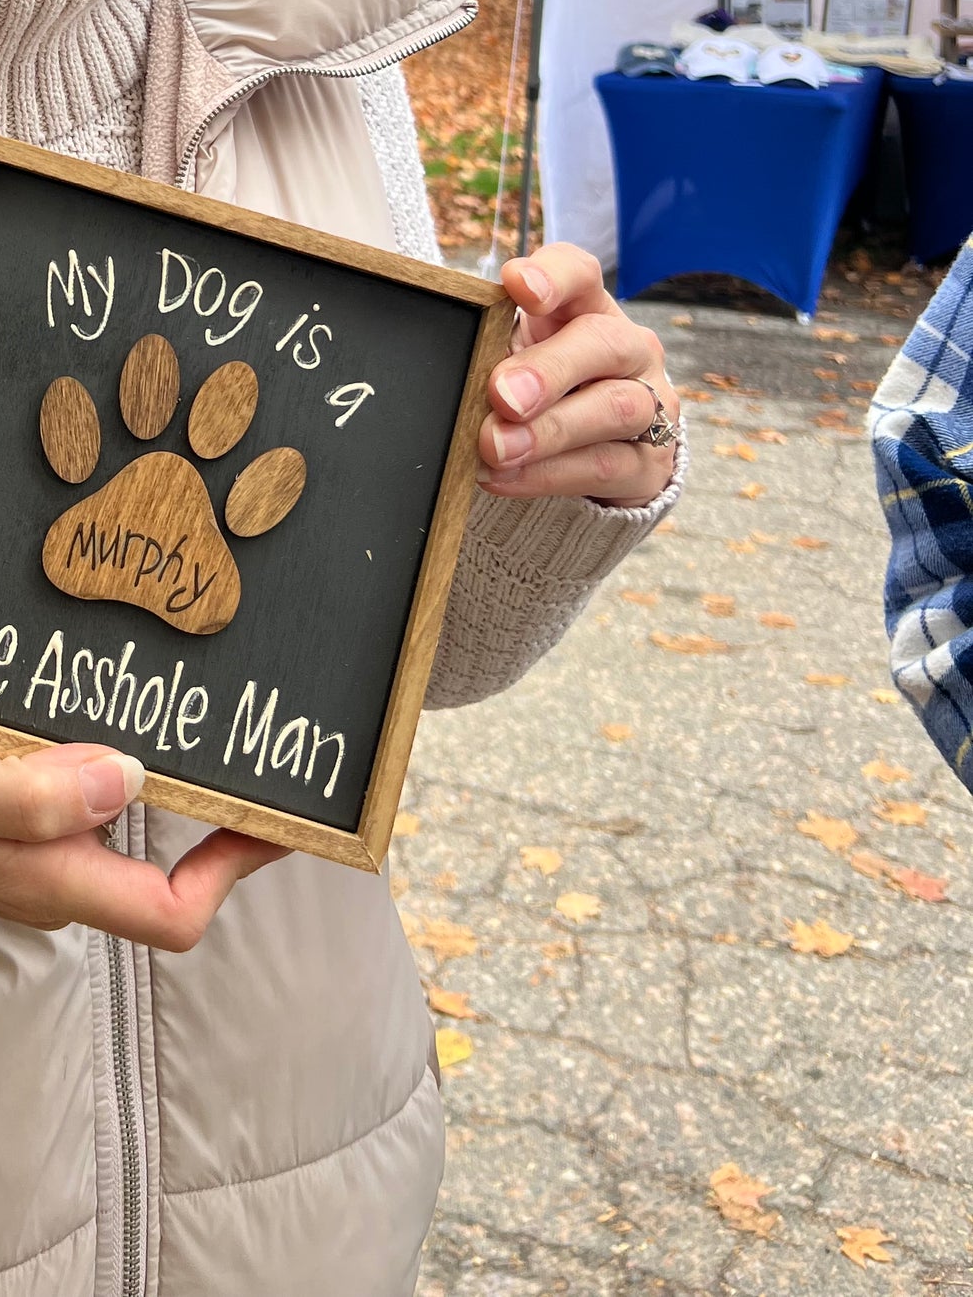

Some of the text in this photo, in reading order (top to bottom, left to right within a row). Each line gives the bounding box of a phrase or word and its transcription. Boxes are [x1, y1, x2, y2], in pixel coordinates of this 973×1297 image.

[47, 248, 375, 428] My Dog is a
[66, 521, 218, 613] Murphy
[23, 629, 209, 752] Asshole
[223, 680, 346, 798] Man
